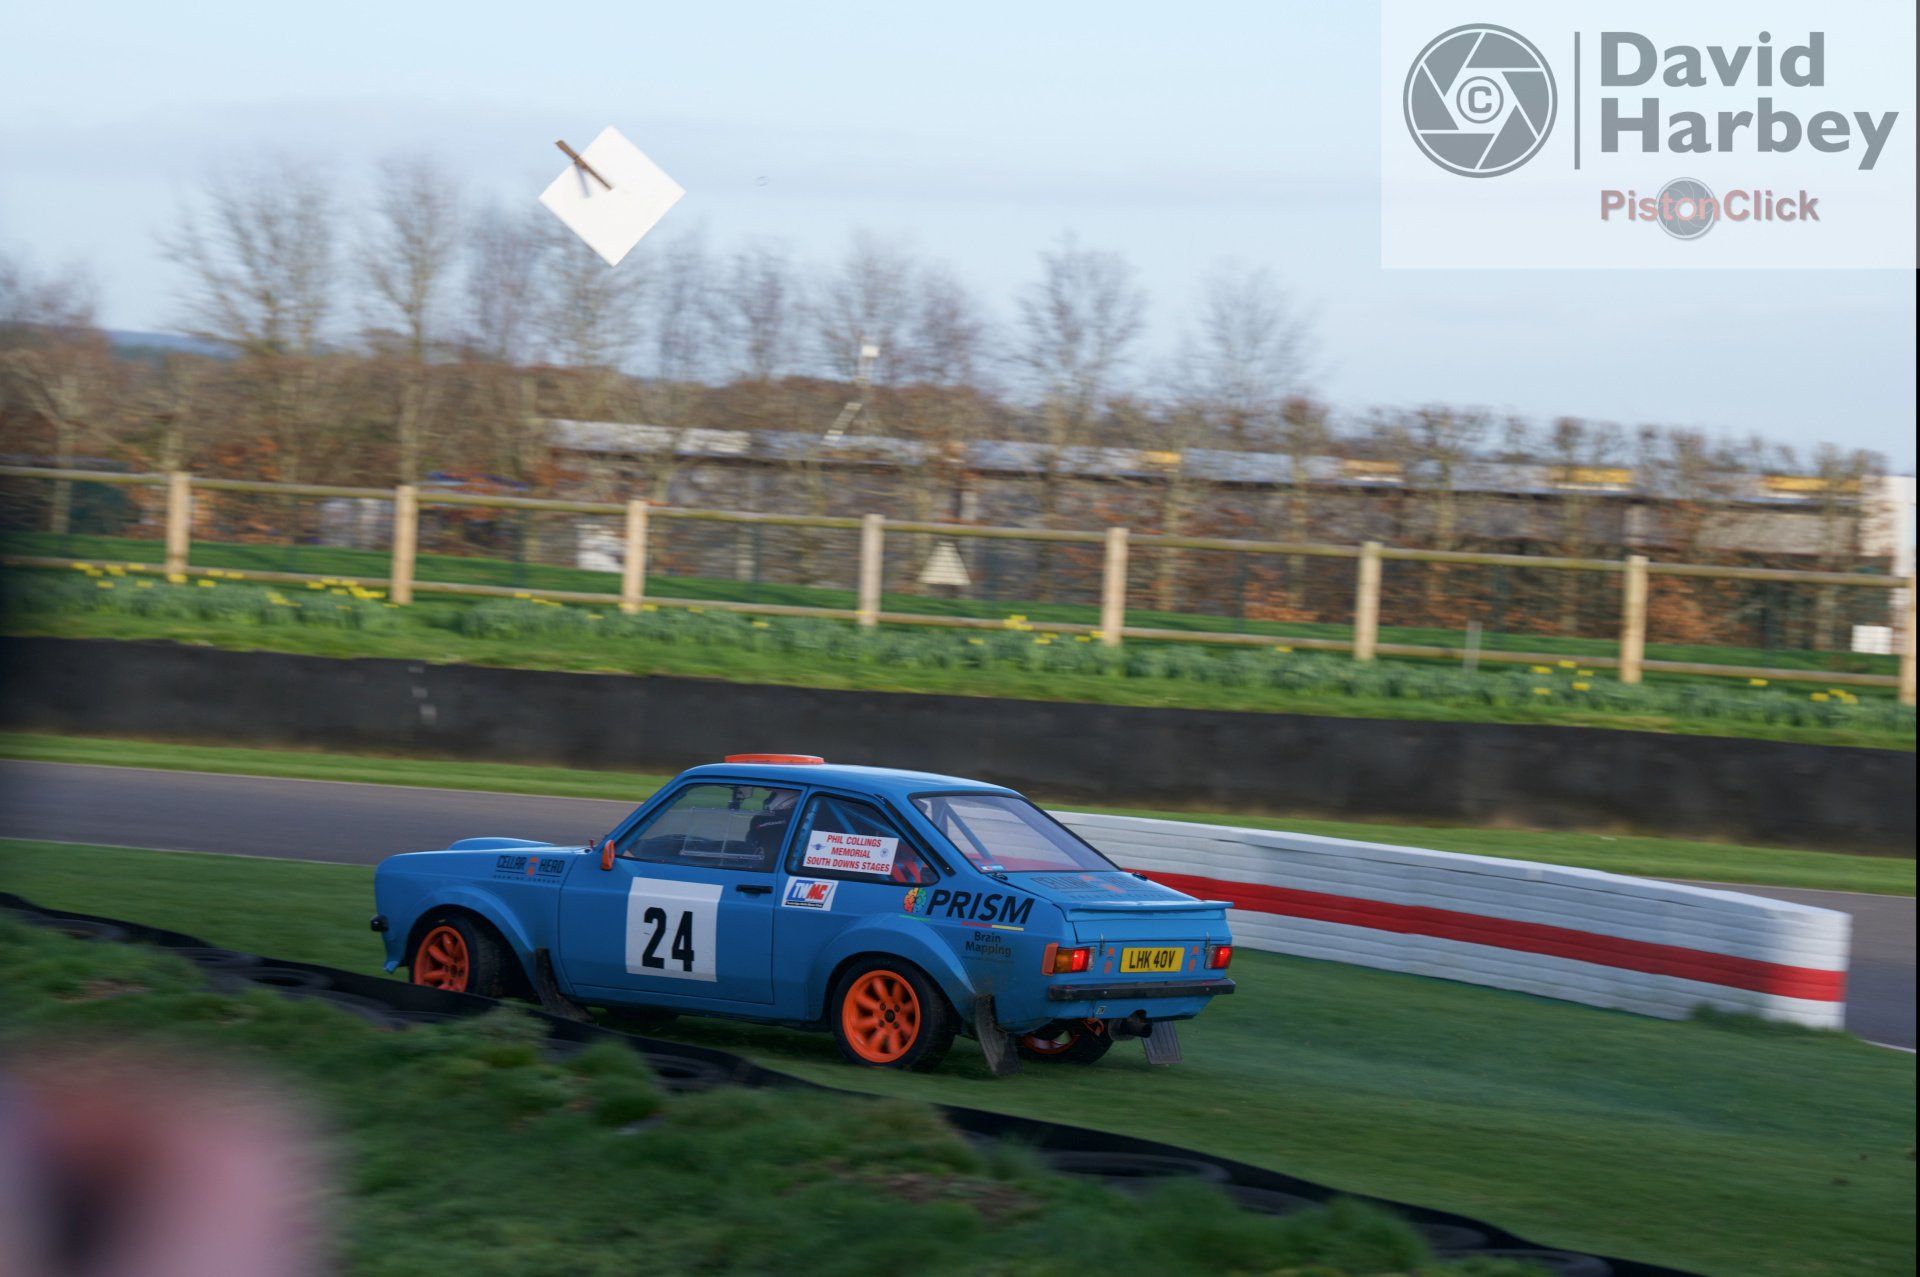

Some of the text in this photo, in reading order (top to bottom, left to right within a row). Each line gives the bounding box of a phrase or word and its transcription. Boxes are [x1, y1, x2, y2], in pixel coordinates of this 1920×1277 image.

[826, 835, 882, 848] PHIL COLLINGS
[831, 847, 871, 858] MEMORIAL
[806, 856, 890, 872] SOUTH DOWNS STAGES
[925, 889, 1035, 924] PRISM
[642, 907, 695, 972] 24
[974, 931, 1002, 943] Brain
[965, 941, 1012, 957] Mapping
[1128, 950, 1176, 969] LHK 40V
